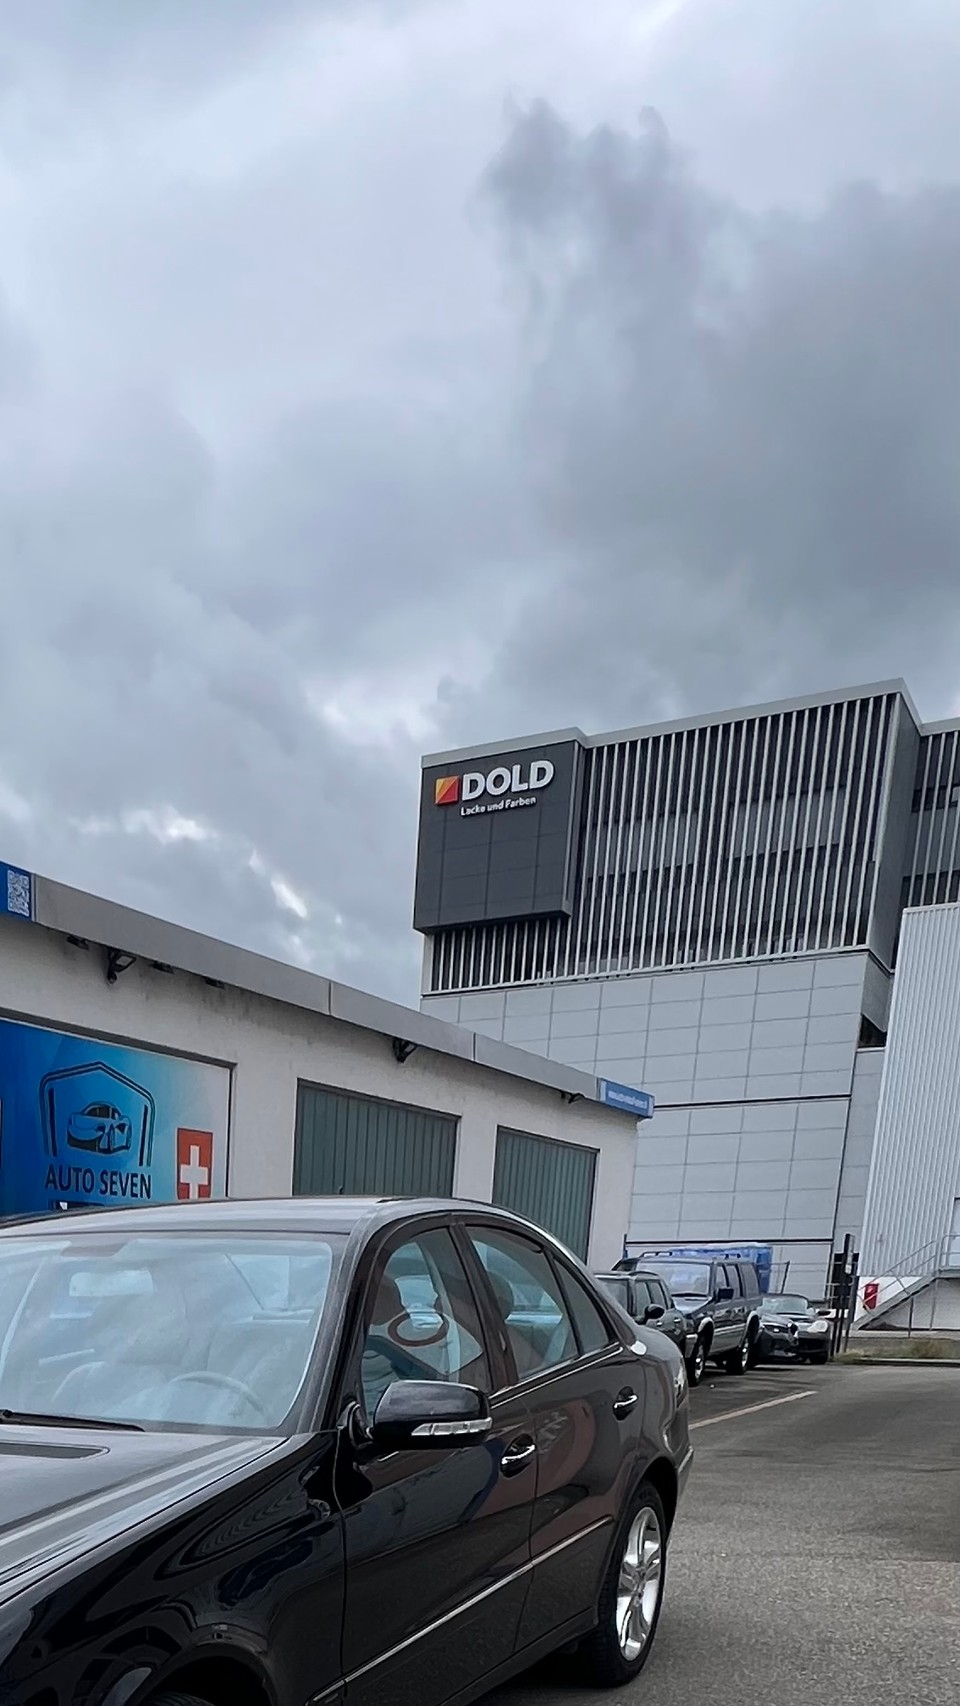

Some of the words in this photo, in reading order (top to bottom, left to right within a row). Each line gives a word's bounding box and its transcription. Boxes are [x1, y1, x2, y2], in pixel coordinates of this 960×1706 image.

[461, 760, 554, 801] DOLD
[460, 804, 486, 817] Lacke
[487, 799, 504, 813] und
[505, 796, 537, 810] Farben
[44, 1164, 95, 1193] AUTO
[99, 1169, 152, 1200] SEVEN
